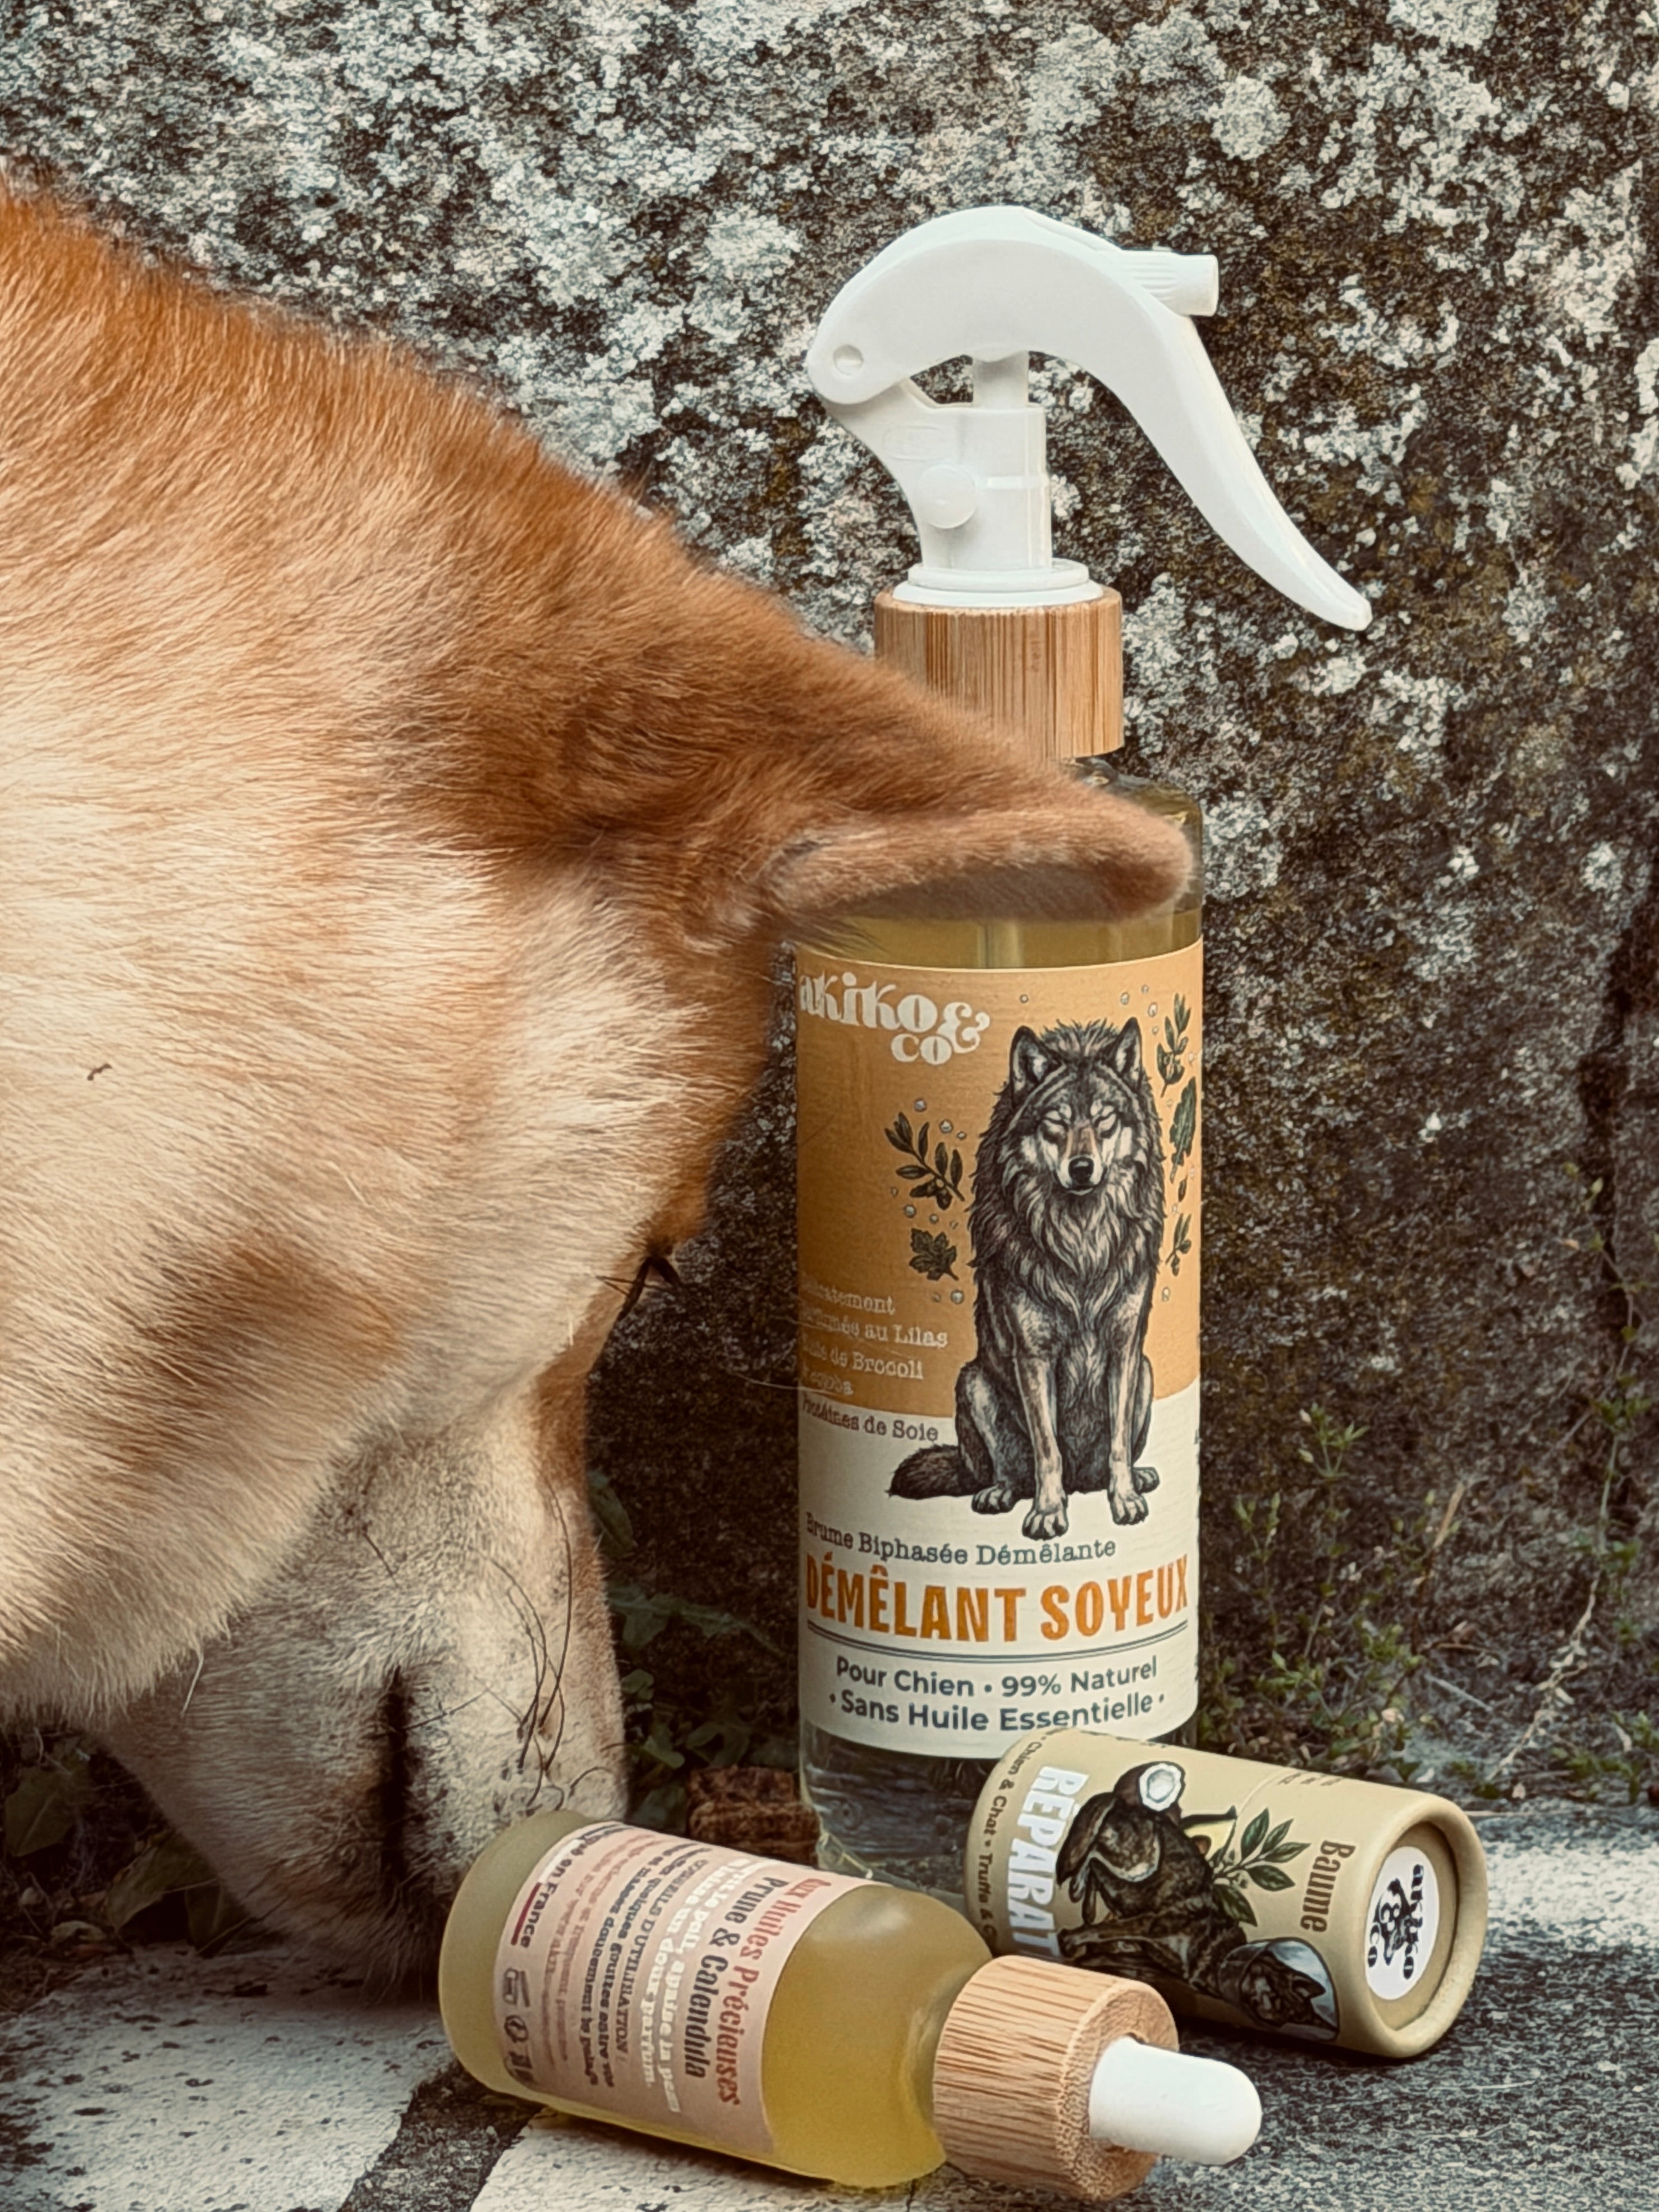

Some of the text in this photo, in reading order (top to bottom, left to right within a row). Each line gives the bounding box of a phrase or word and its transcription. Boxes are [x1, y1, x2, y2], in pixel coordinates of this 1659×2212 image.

[864, 1325, 888, 1342] au
[894, 1324, 948, 1348] Lilas
[863, 1415, 887, 1436] de
[892, 1419, 939, 1442] Soie
[806, 1511, 1117, 1566] Brume Biphasée Démêlante
[806, 1551, 1189, 1642] DÉMÊLANT SOYEUX
[836, 1654, 1157, 1697] Pour Chien 99% Naturel
[841, 1689, 1153, 1732] Sans Huile Essentielle
[1008, 1740, 1043, 1776] Chien
[983, 1795, 1007, 1836] Chat
[724, 1876, 790, 1924] Prune
[1300, 1839, 1356, 1933] Baume
[520, 1881, 558, 1949] France
[709, 1927, 741, 1947] &
[739, 1899, 802, 1961] Huiles
[684, 1954, 728, 2078] Calendula
[716, 1966, 760, 2105] Précieuses
